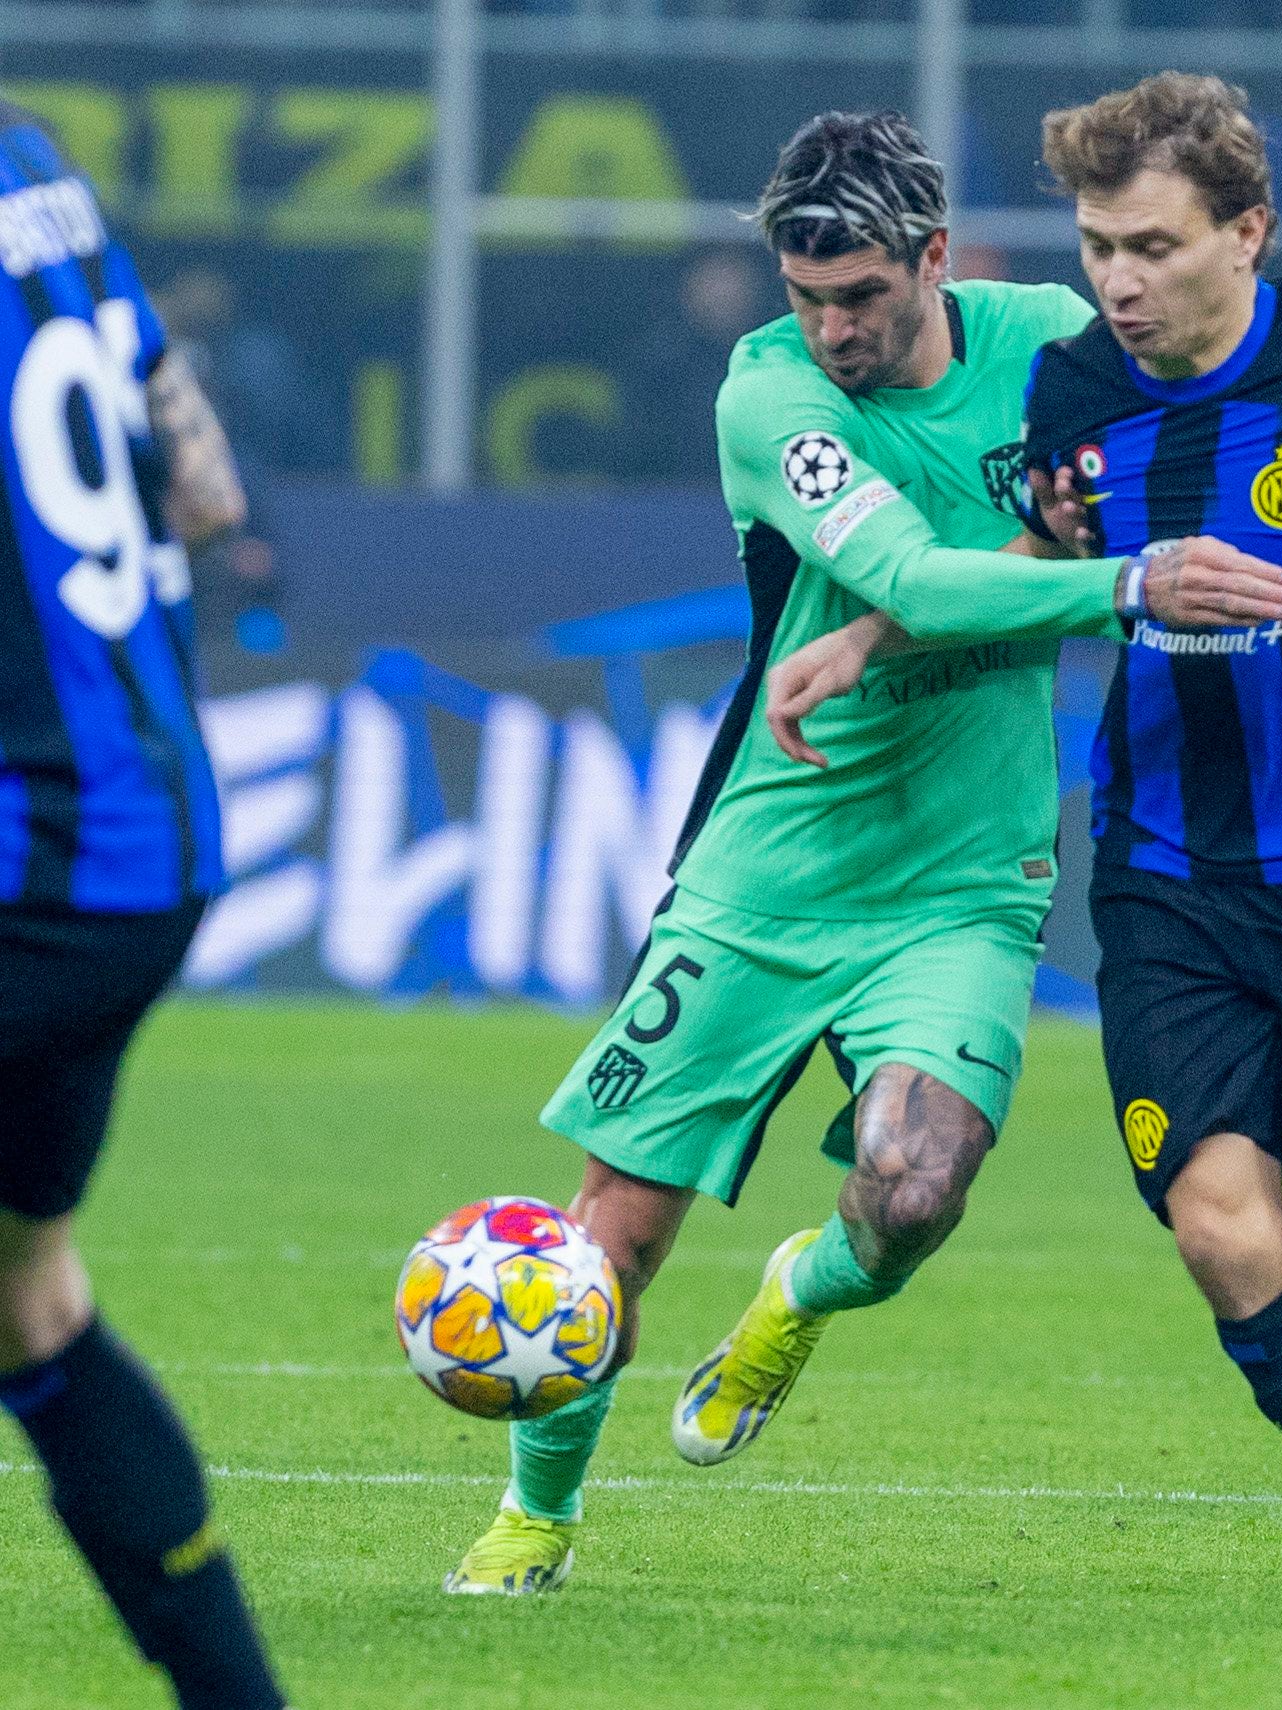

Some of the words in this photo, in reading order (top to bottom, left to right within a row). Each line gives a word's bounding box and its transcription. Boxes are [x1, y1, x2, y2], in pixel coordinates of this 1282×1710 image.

[856, 654, 952, 704] YADH
[960, 640, 1012, 675] AIR
[623, 952, 706, 1045] 5
